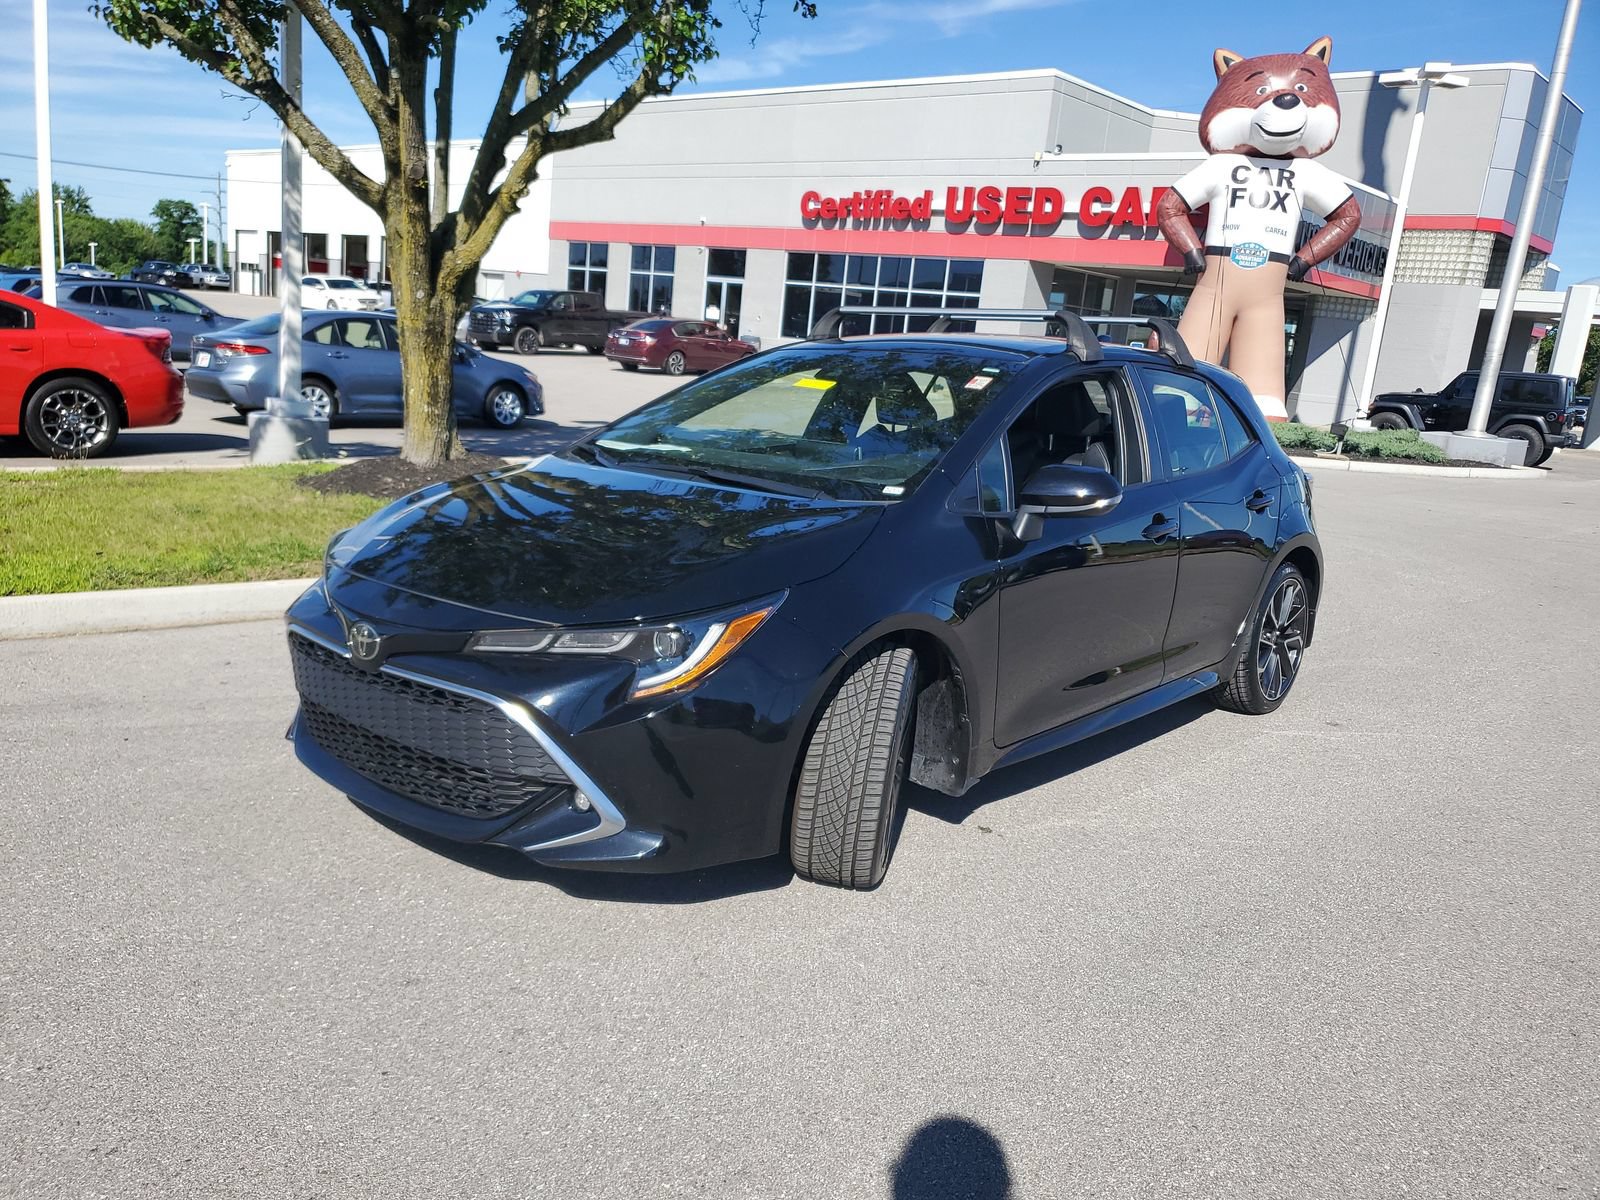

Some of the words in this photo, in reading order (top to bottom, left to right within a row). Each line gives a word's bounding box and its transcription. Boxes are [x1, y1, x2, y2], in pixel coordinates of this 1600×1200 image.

[1231, 165, 1295, 190] CAR
[801, 190, 934, 220] Certified
[944, 186, 1064, 224] USED
[1229, 187, 1291, 214] FOX
